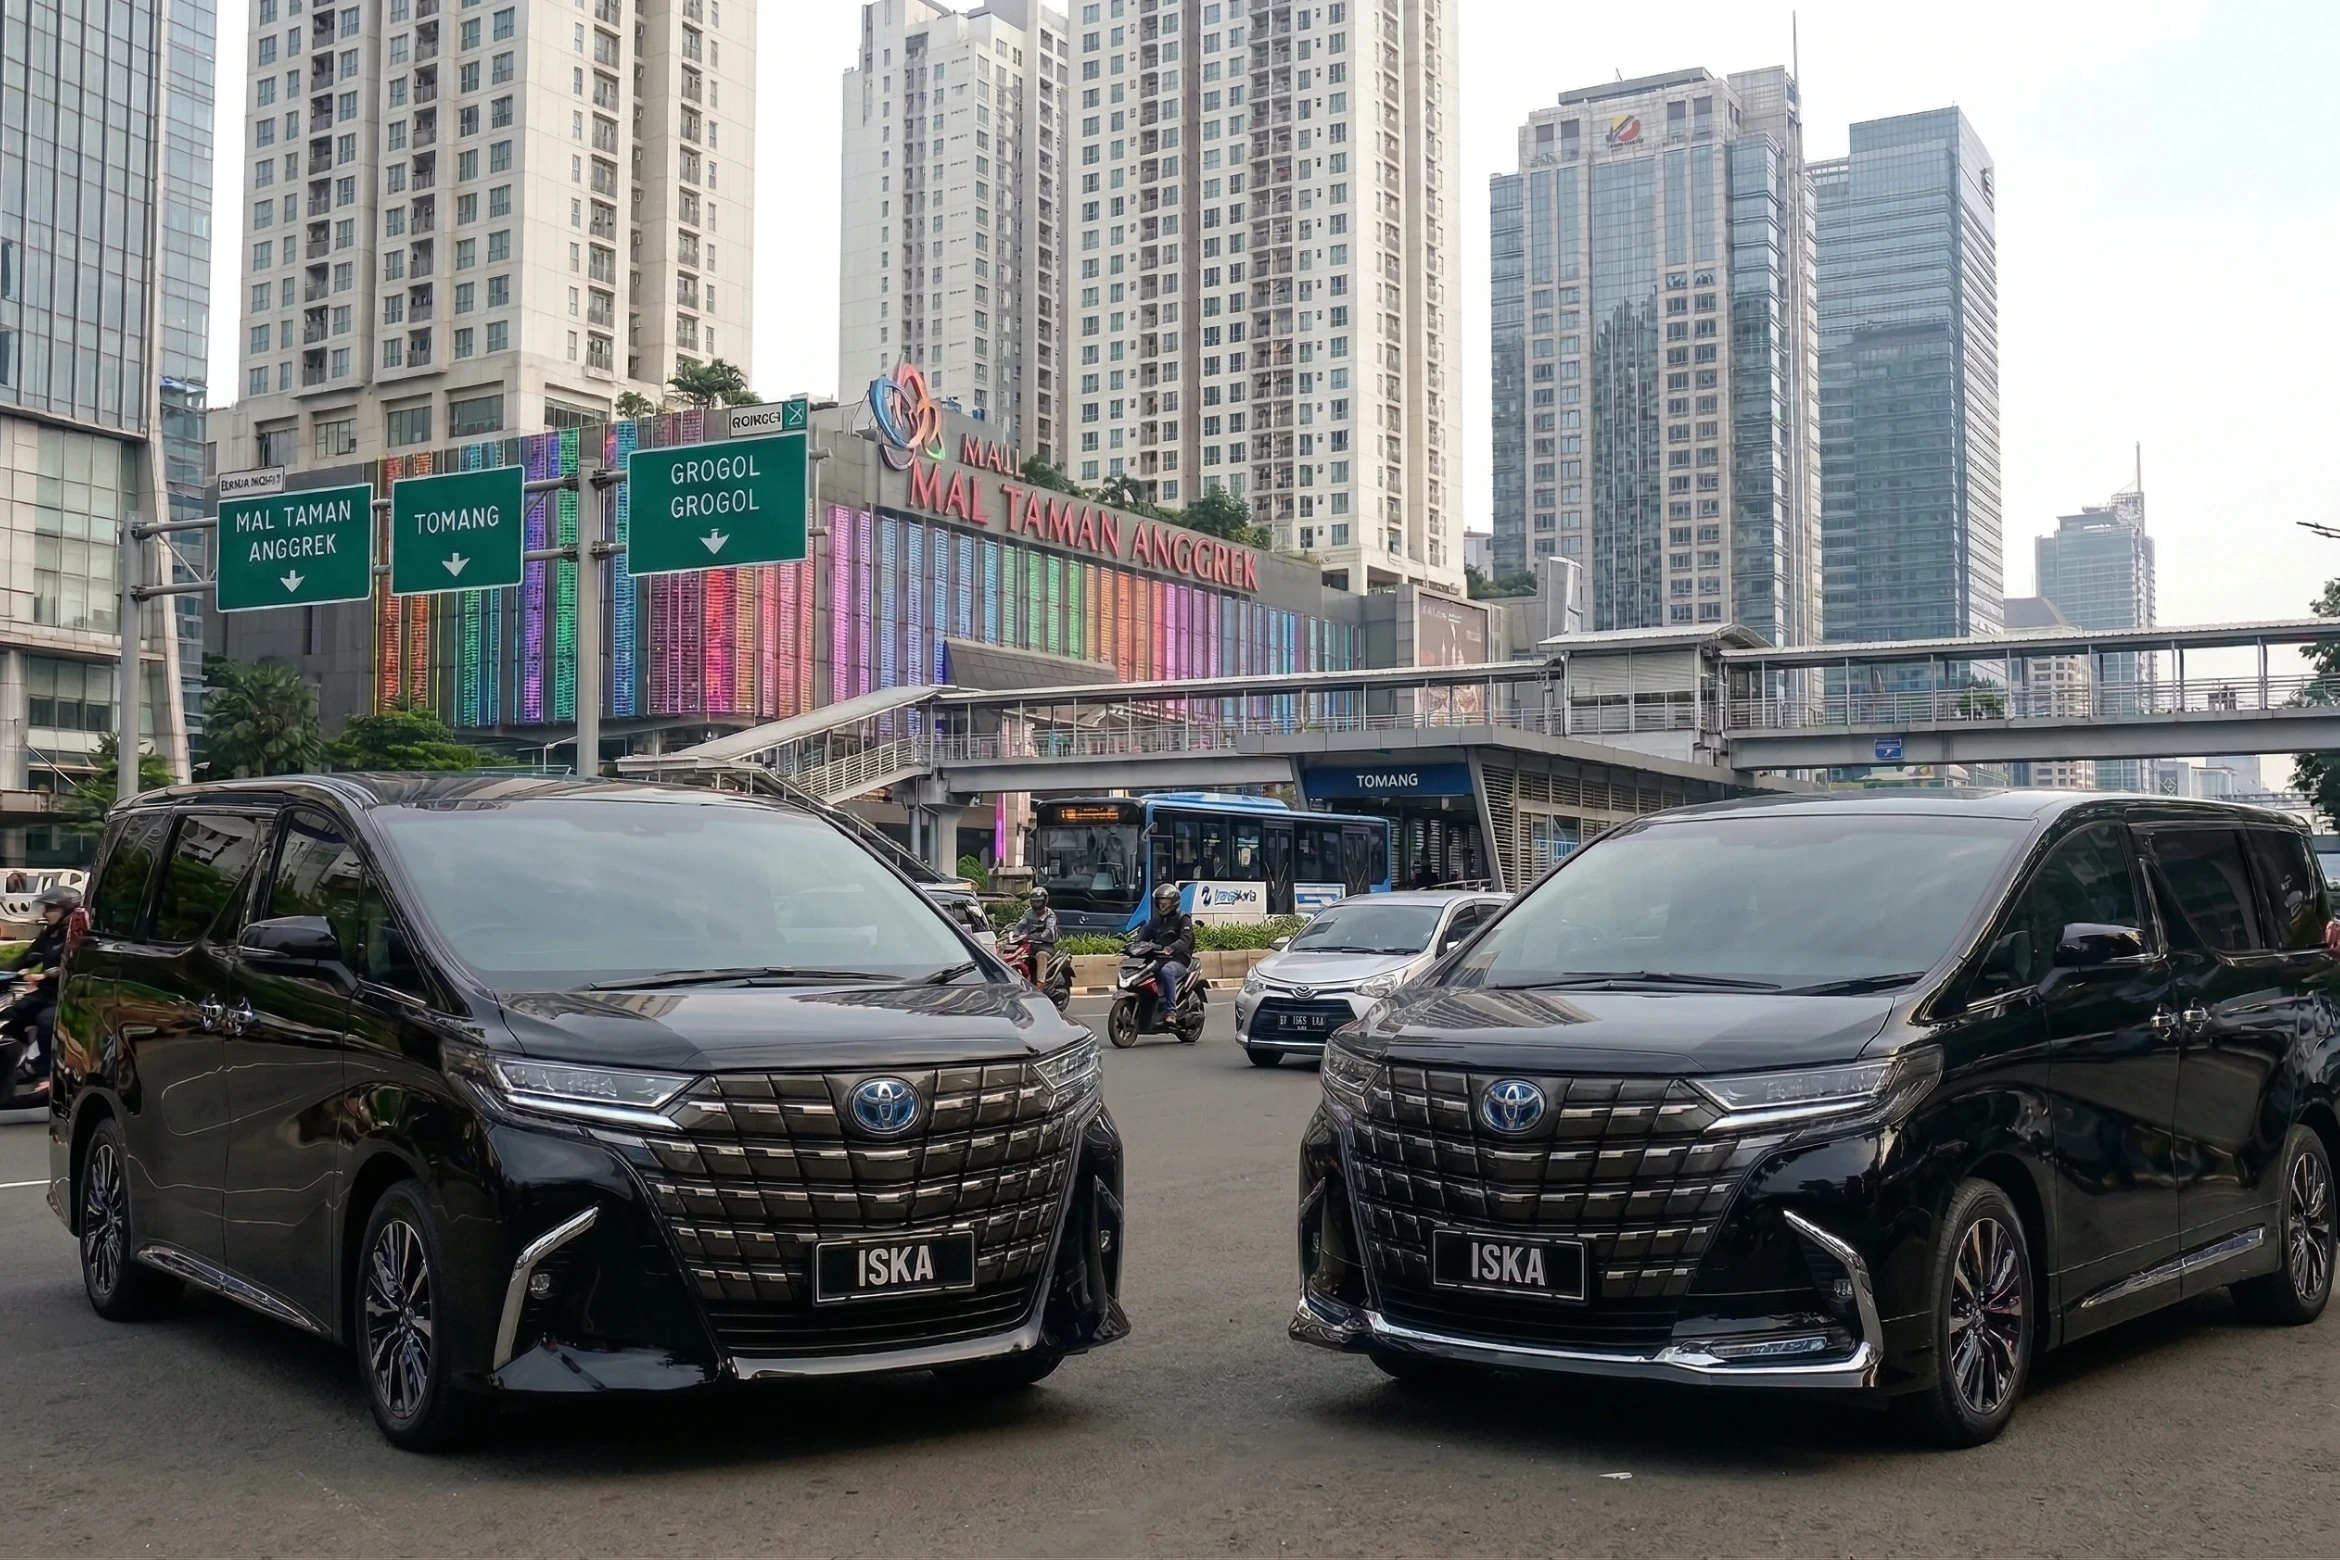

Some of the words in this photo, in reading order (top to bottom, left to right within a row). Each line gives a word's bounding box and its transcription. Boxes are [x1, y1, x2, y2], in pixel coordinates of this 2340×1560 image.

[671, 454, 761, 485] GROGOL
[961, 432, 1025, 478] MALL
[236, 509, 275, 533] MAL
[283, 499, 351, 527] TAMAN
[671, 488, 760, 519] GROGOL
[414, 505, 499, 535] TOMANG
[909, 459, 990, 525] MAL
[1001, 483, 1121, 558] TAMAN
[1129, 520, 1259, 592] ANGGREK
[249, 533, 337, 562] ANGGREK
[1356, 773, 1418, 788] TOMANG
[858, 1244, 934, 1287] ISKA
[1471, 1242, 1546, 1286] ISKA
